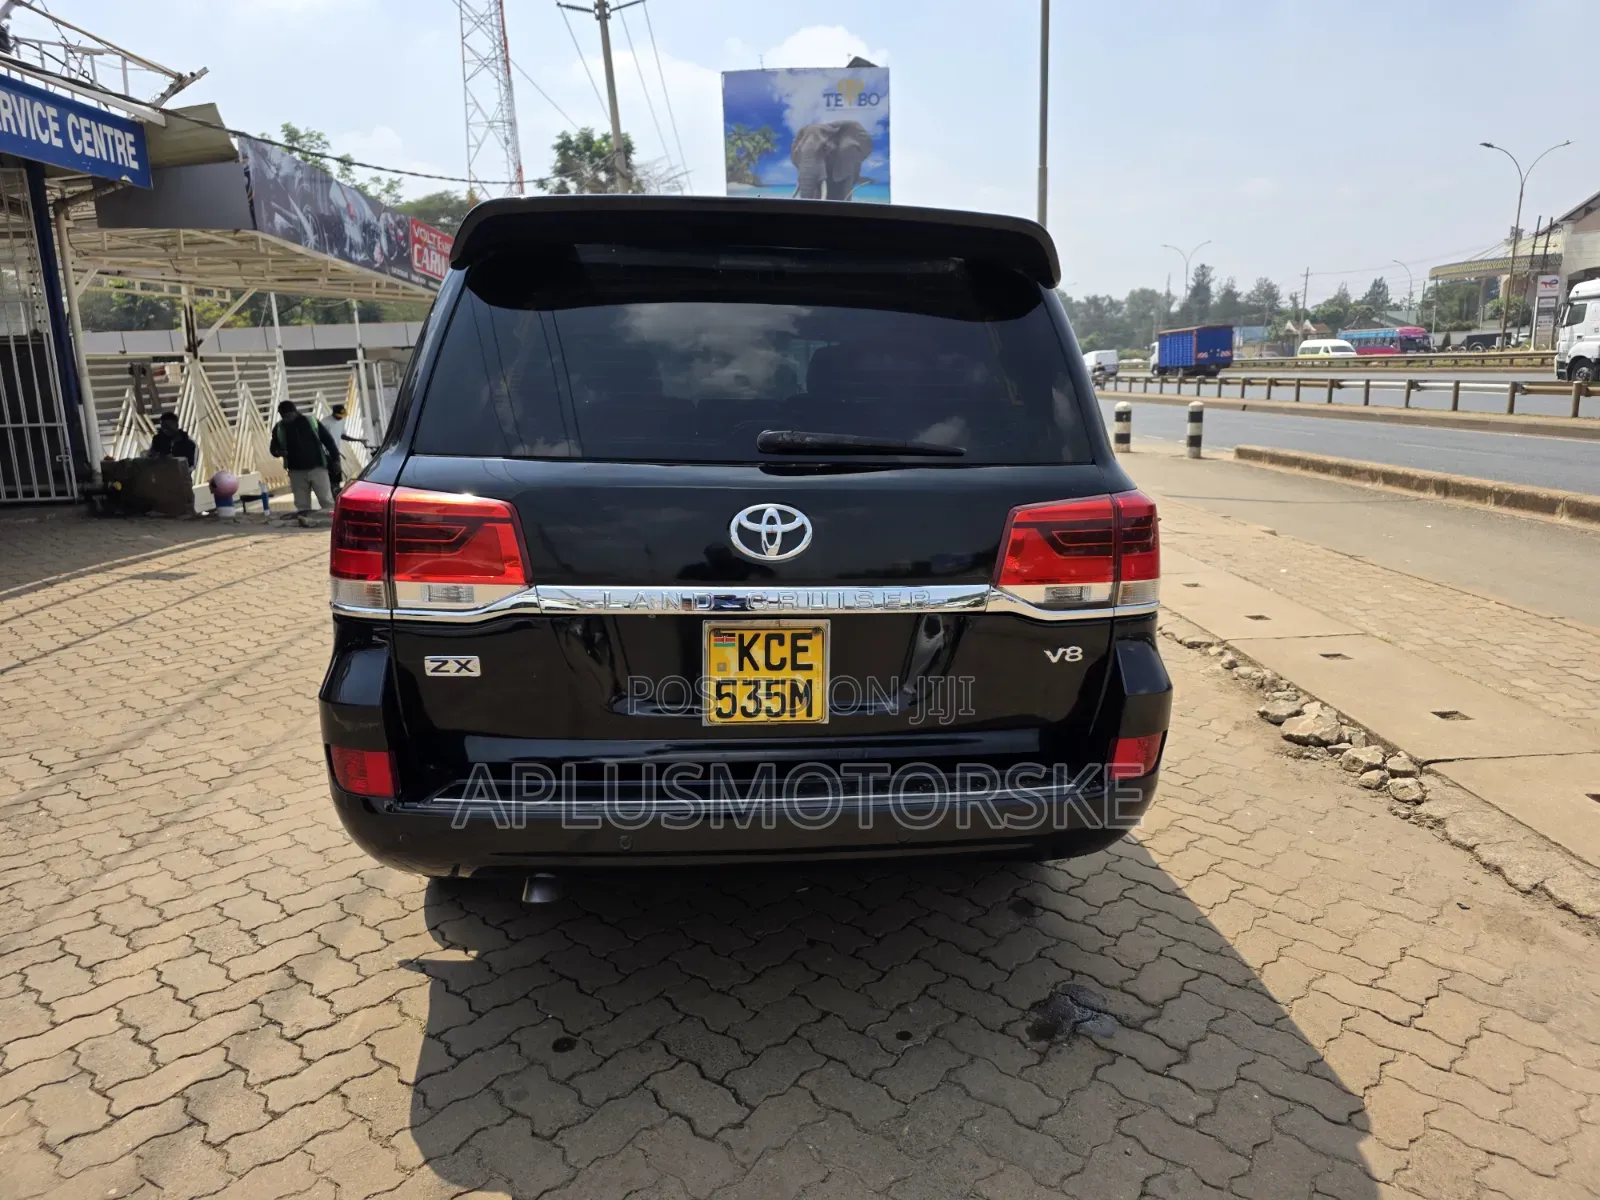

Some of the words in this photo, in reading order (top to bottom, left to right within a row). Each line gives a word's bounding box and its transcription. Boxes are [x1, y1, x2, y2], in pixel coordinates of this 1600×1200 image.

[0, 90, 63, 148] RVICE
[67, 113, 139, 170] CENTRE
[604, 591, 715, 611] LAND
[746, 590, 931, 611] CRUISER
[430, 659, 475, 674] ZX
[738, 633, 814, 671] KCE
[1043, 645, 1083, 663] V8
[715, 679, 813, 719] 535M
